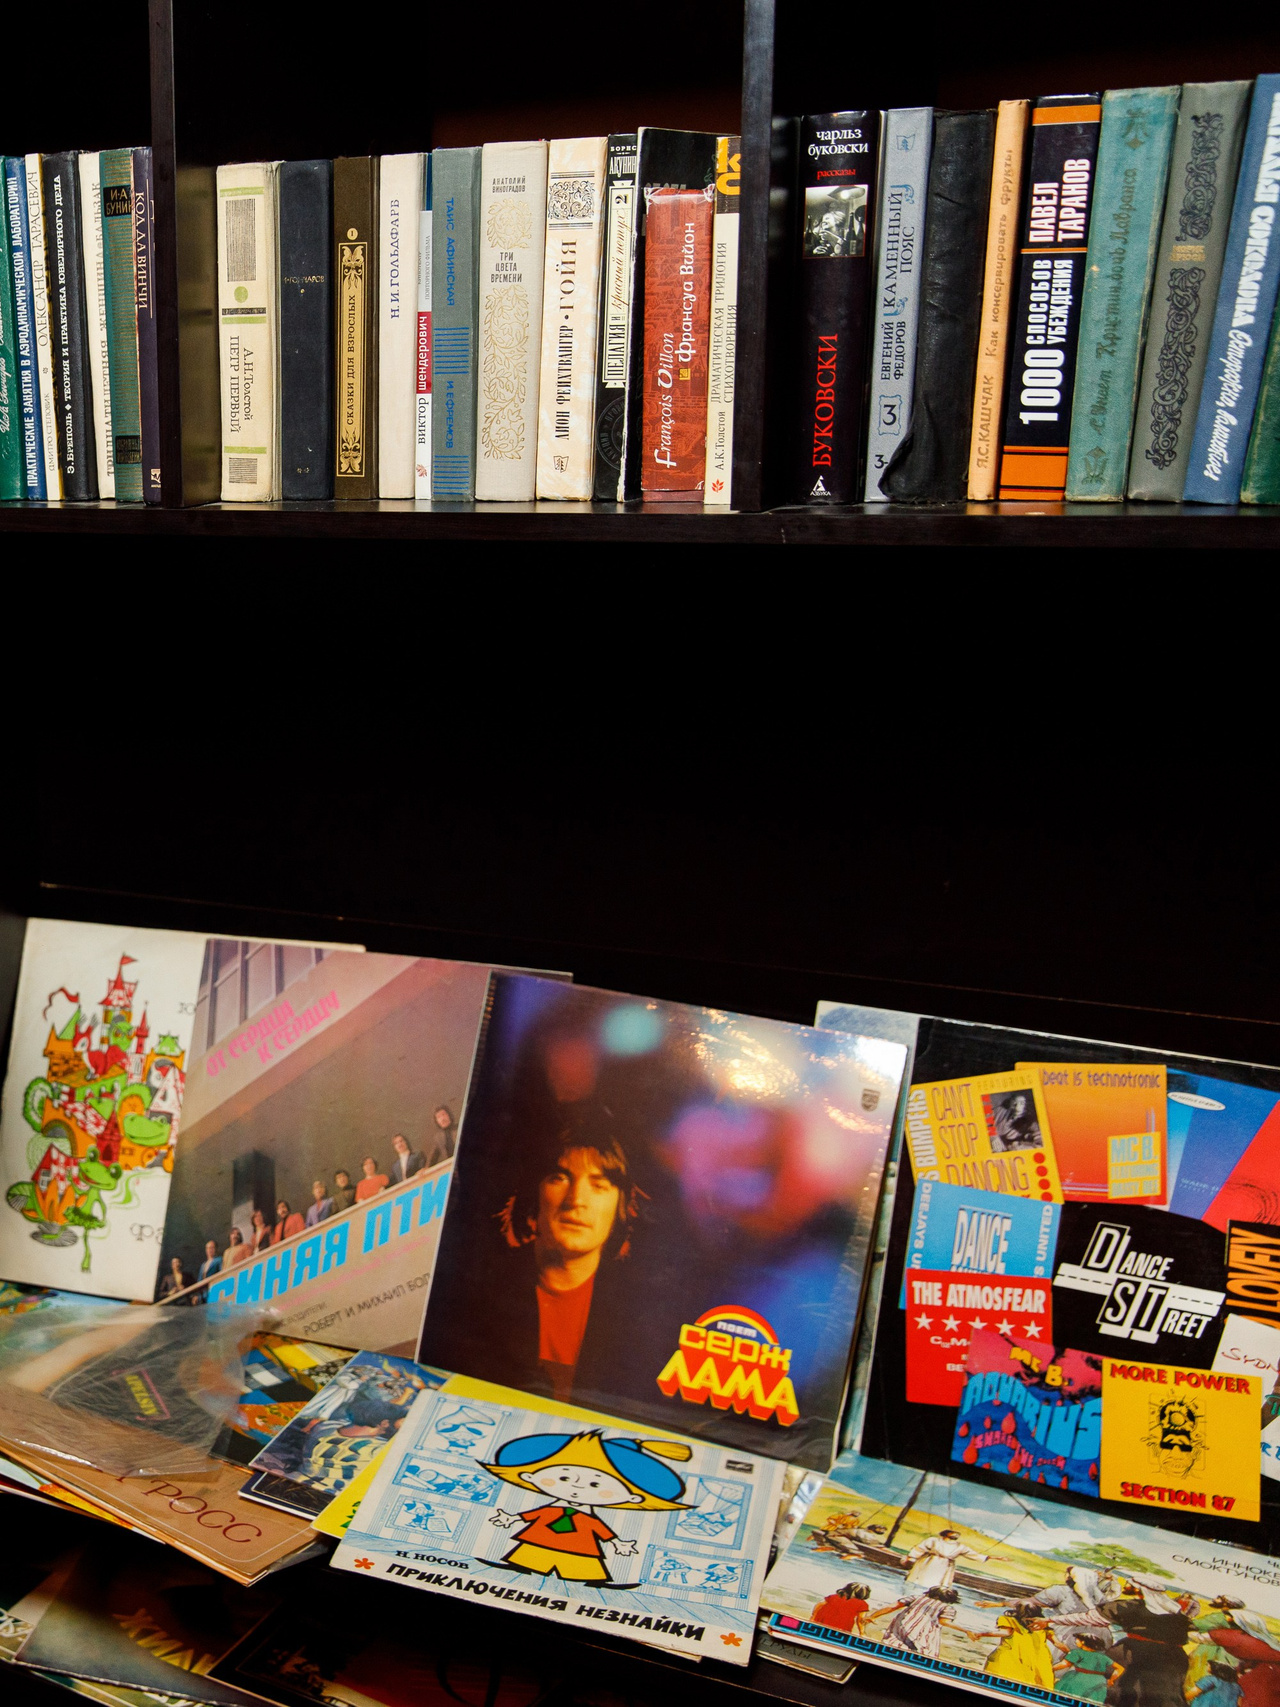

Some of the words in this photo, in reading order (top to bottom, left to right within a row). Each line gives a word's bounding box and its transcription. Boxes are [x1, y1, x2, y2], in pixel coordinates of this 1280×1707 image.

[807, 142, 869, 160] буковски
[815, 128, 863, 145] чарльз
[53, 174, 63, 206] ДЕЛА
[492, 176, 526, 186] АНАТОЛИЙ
[492, 183, 526, 193] ВИНОГРАДОВ
[609, 156, 637, 178] АКУНИН
[816, 168, 856, 180] рассказы
[1000, 149, 1013, 206] фрукты
[7, 176, 23, 246] ЛАБОРАТОРИИ
[27, 171, 43, 252] ТАРАСЕВИЧ
[134, 191, 146, 227] КОД
[445, 198, 455, 231] ТАИС
[615, 193, 629, 205] 2
[1028, 181, 1059, 243] ПАВЕЛ
[1057, 158, 1091, 243] ТАРАНОВ
[54, 209, 66, 285] ЮВЕЛИРНОГО
[135, 229, 147, 253] ДА
[495, 263, 518, 273] ЦВЕТА
[499, 252, 514, 262] ТРИ
[679, 222, 696, 276] Вийон
[883, 191, 903, 309] КАМЕННЫЙ
[899, 225, 915, 274] ПОЯС
[991, 213, 1008, 323] консервировать
[137, 255, 148, 309] ВИНЧИ
[446, 236, 455, 306] АФИНСКАЯ
[490, 273, 523, 283] ВРЕМЕНИ
[555, 240, 578, 312] ГОЙЯ
[714, 242, 727, 304] ТРИЛОГИЯ
[11, 251, 31, 357] АЭРОДИНАМИЧЕСКОЙ
[33, 260, 49, 347] ОЛЕКСАНДР
[58, 286, 69, 345] ПРАКТИКА
[346, 294, 356, 354] ВЗРОСЛЫХ
[674, 281, 698, 363] Франсуа
[1025, 259, 1052, 345] СПОСОБОВ
[1046, 259, 1073, 345] УБЕЖДЕНИЯ
[20, 358, 31, 367] В
[62, 347, 69, 357] И
[229, 335, 240, 372] ПЕТР
[346, 356, 356, 379] ДЛЯ
[419, 316, 431, 391] шендерович
[556, 325, 574, 405] ФЕЙХТВАНГЕР
[607, 324, 626, 377] ПЕЛАГИЯ
[710, 307, 725, 404] ДРАМАТИЧЕСКАЯ
[723, 304, 738, 404] СТИХОТВОРЕНИЯ
[880, 321, 895, 381] ЕВГЕНИЙ
[893, 320, 906, 381] ФЕДОРОВ
[985, 330, 999, 357] Как
[21, 369, 34, 414] ЗАНЯТИЯ
[62, 359, 72, 402] ТЕОРИЯ
[230, 375, 241, 433] ПЕРВЫЙ
[243, 347, 254, 421] А.Н.Толстой
[346, 381, 356, 426] СКАЗКИ
[812, 333, 839, 468] БУКОВСКИ
[1019, 348, 1065, 426] 1000
[417, 397, 430, 445] виктор
[555, 411, 570, 441] ЛИОН
[882, 404, 897, 426] 3
[23, 416, 39, 487] ПРАКТИЧЕСКИЕ
[206, 1049, 227, 1077] ОТ
[257, 1041, 273, 1064] К
[1042, 1068, 1069, 1087] beat
[1073, 1070, 1083, 1087] is
[1087, 1071, 1161, 1089] technotronic
[906, 1089, 938, 1168] BUMPERS
[931, 1083, 975, 1121] CAN'T
[938, 1122, 979, 1160] STOP
[1111, 1136, 1138, 1164] MC
[1142, 1135, 1159, 1161] B.
[946, 1156, 1030, 1193] DANCING
[913, 1183, 933, 1250] DEEJAYS
[951, 1207, 1013, 1275] DANCE
[1036, 1205, 1054, 1262] UNITED
[205, 1221, 352, 1308] СИНЯЯ
[1086, 1227, 1174, 1281] DANCE
[303, 1310, 342, 1336] РОБЕРТ
[345, 1307, 355, 1318] И
[357, 1287, 406, 1314] МИХАИЛ
[912, 1281, 942, 1306] THE
[946, 1283, 1046, 1314] ATMOSFEAR
[1104, 1281, 1213, 1339] STREET
[656, 1349, 800, 1422] ЛАМА
[1110, 1363, 1169, 1384] MORE
[1174, 1371, 1251, 1395] POWER
[1120, 1481, 1206, 1509] SECTION
[1211, 1495, 1236, 1512] 87
[395, 1549, 410, 1560] Н.
[410, 1552, 470, 1570] НОСОВ
[385, 1563, 569, 1612] ПРИКЛЮЧЕНИЯ
[575, 1604, 706, 1642] НЕЗНАЙКИ
